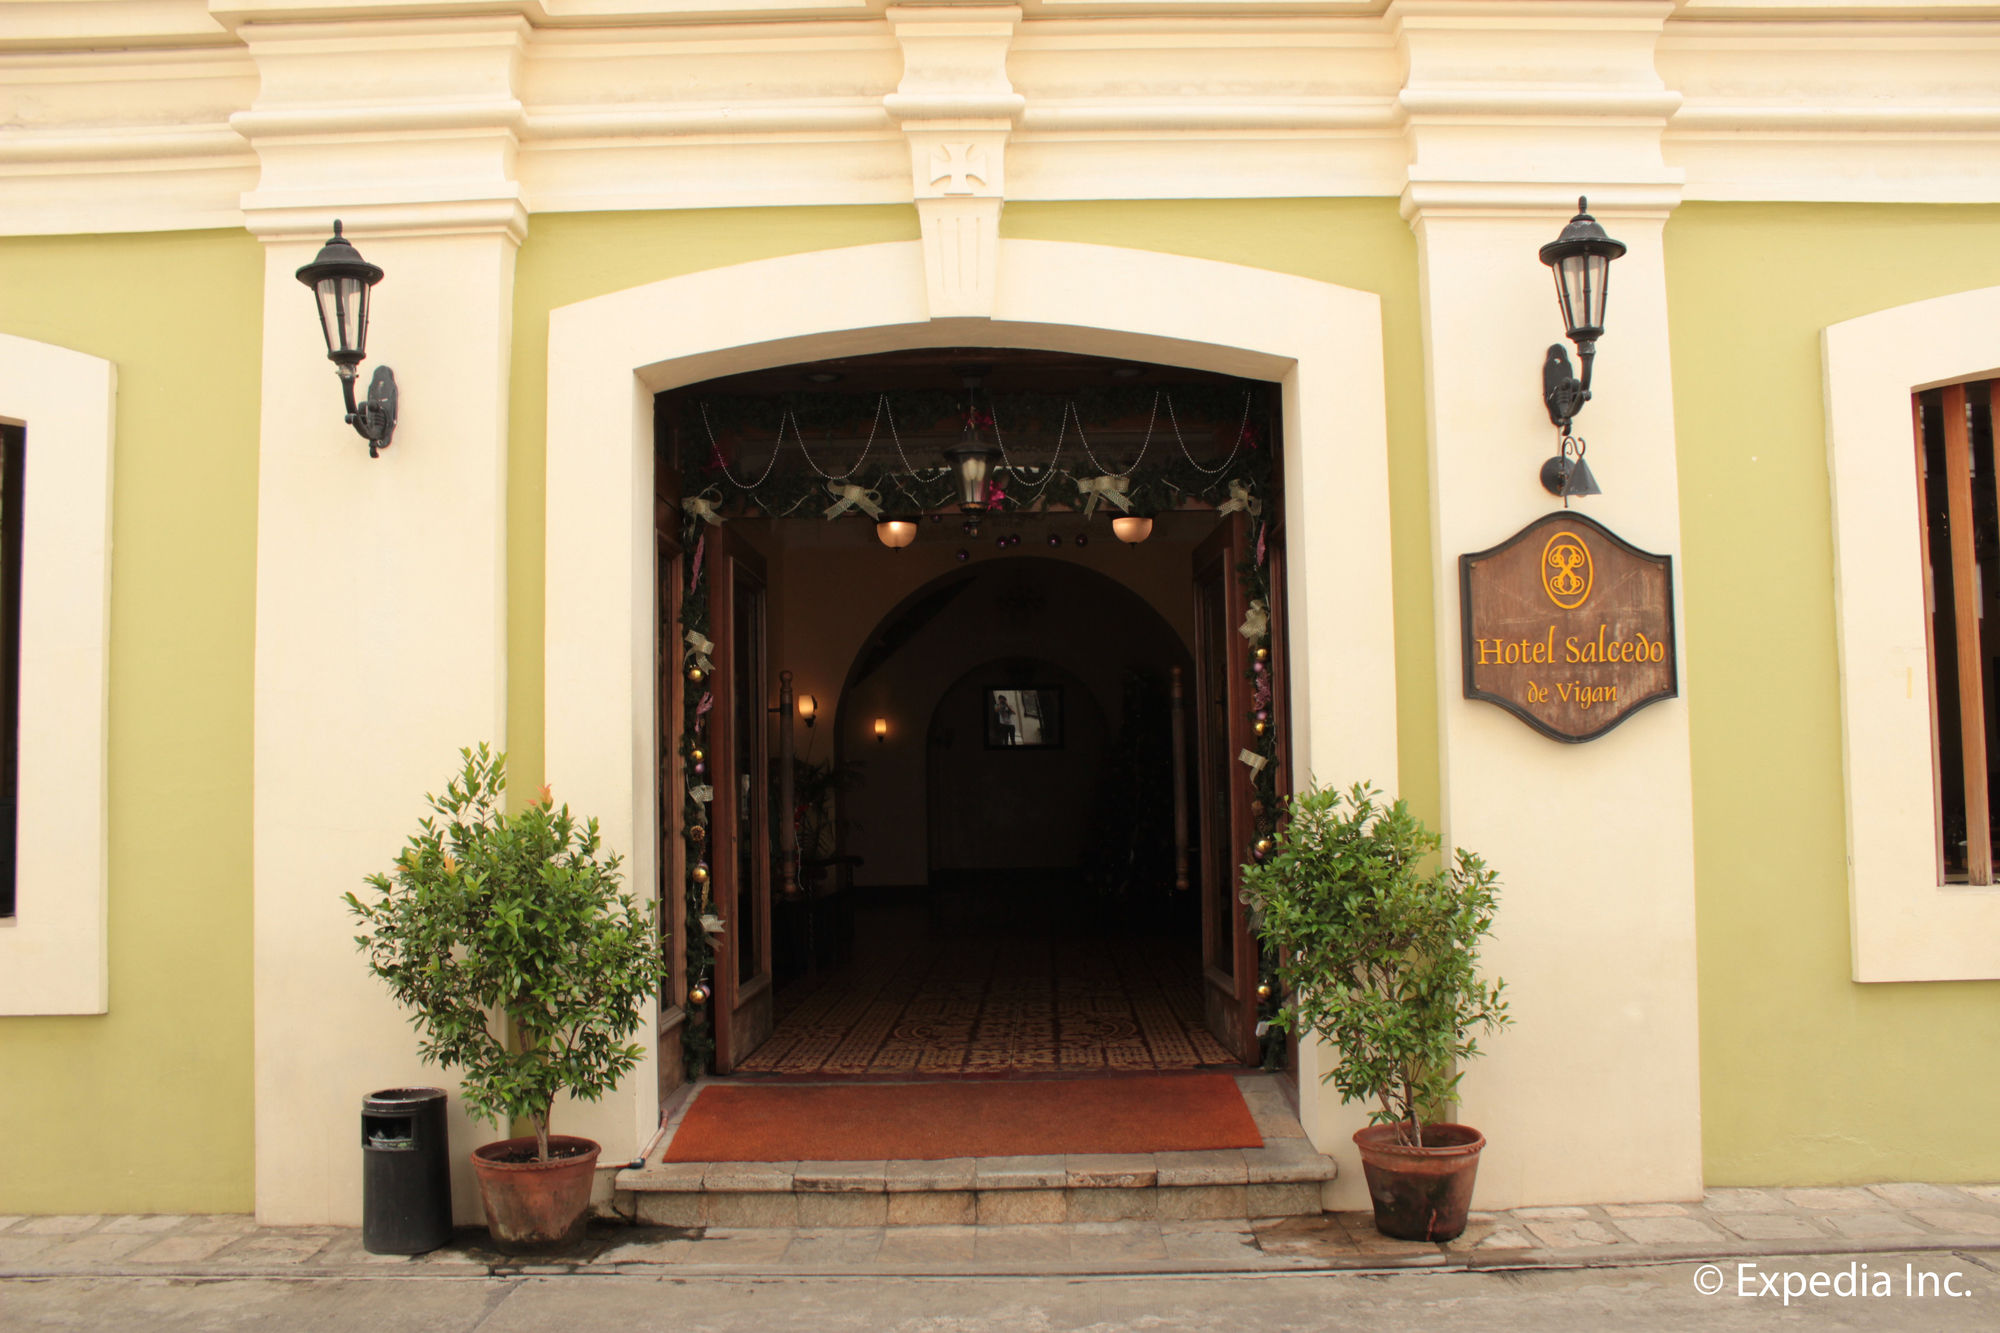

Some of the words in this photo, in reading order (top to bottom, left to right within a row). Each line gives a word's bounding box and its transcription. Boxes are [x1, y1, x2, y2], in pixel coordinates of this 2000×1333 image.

[1476, 625, 1556, 665] Hotel
[1565, 624, 1665, 663] Salcedo
[1527, 681, 1549, 703] de
[1556, 681, 1618, 710] Vigan
